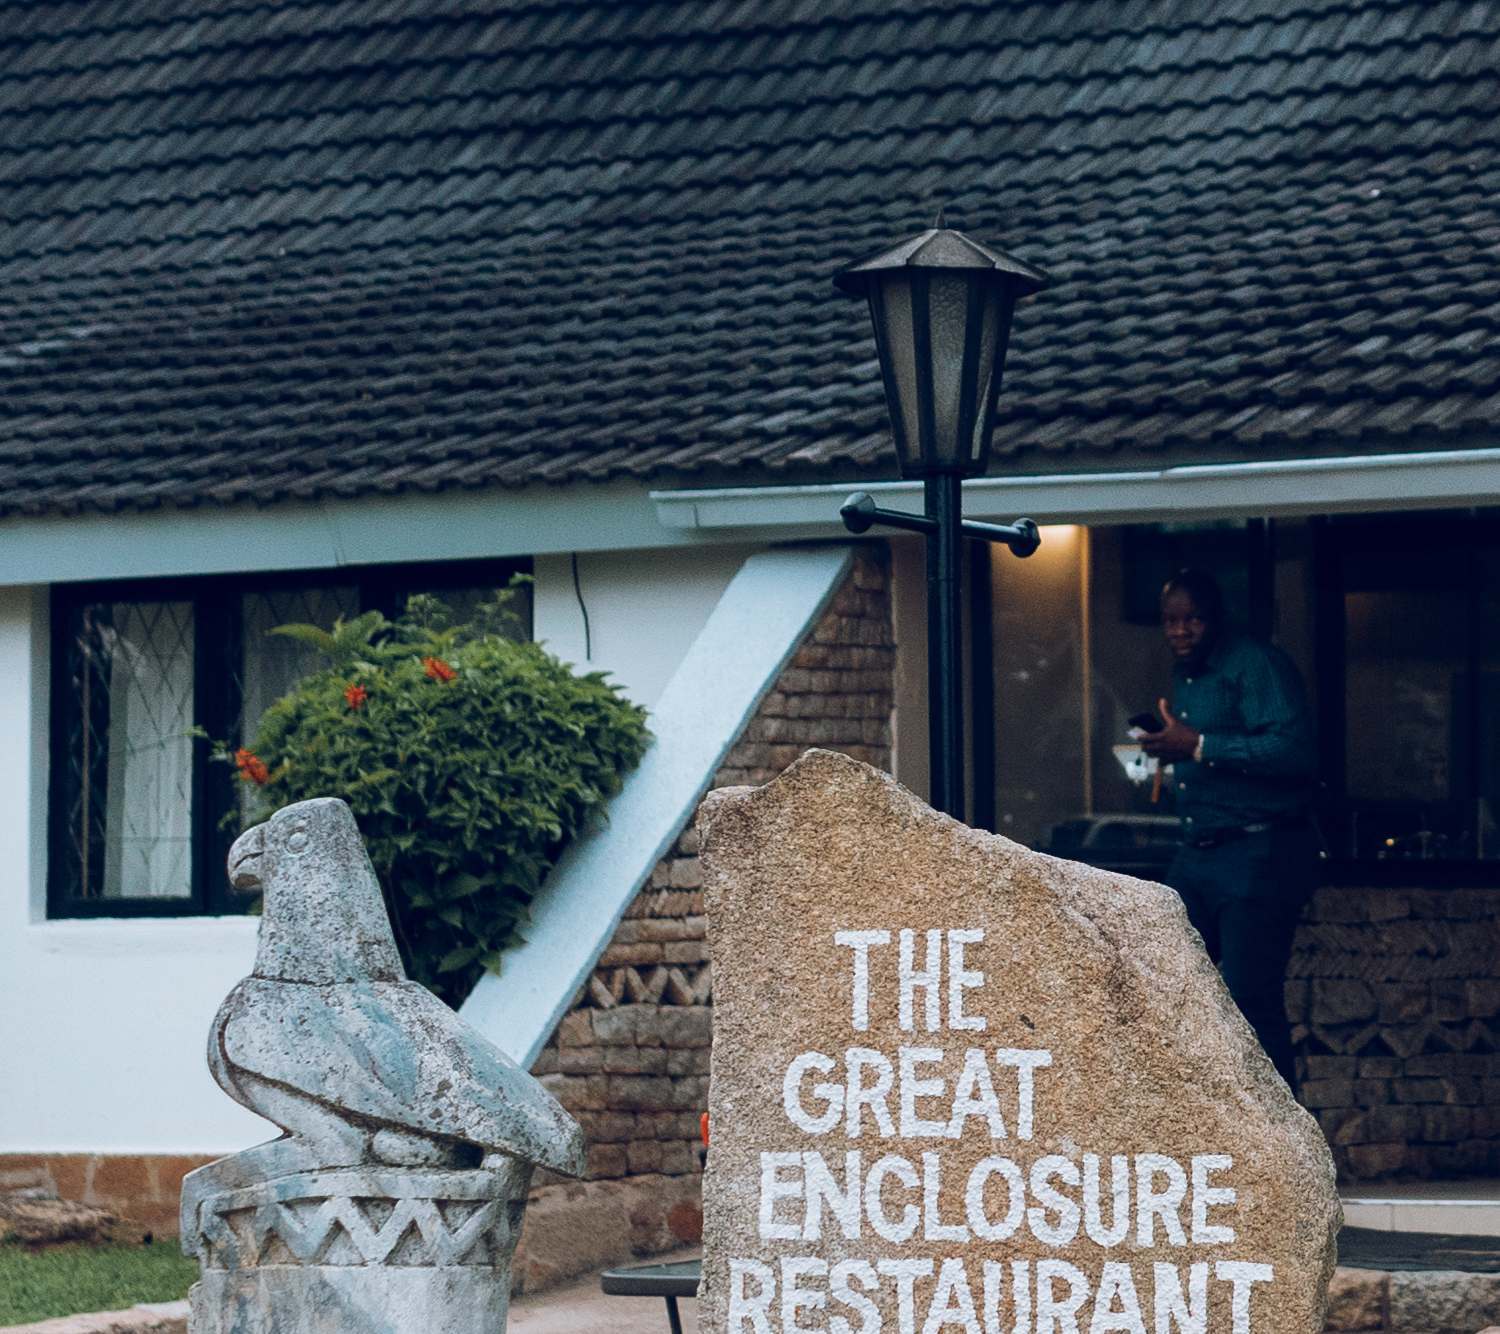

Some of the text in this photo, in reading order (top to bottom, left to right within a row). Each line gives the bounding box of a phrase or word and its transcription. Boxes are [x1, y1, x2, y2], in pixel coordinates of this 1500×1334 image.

[834, 928, 988, 1033] THE
[782, 1047, 1053, 1142] GREAT
[758, 1151, 1237, 1248] ENCLOSURE
